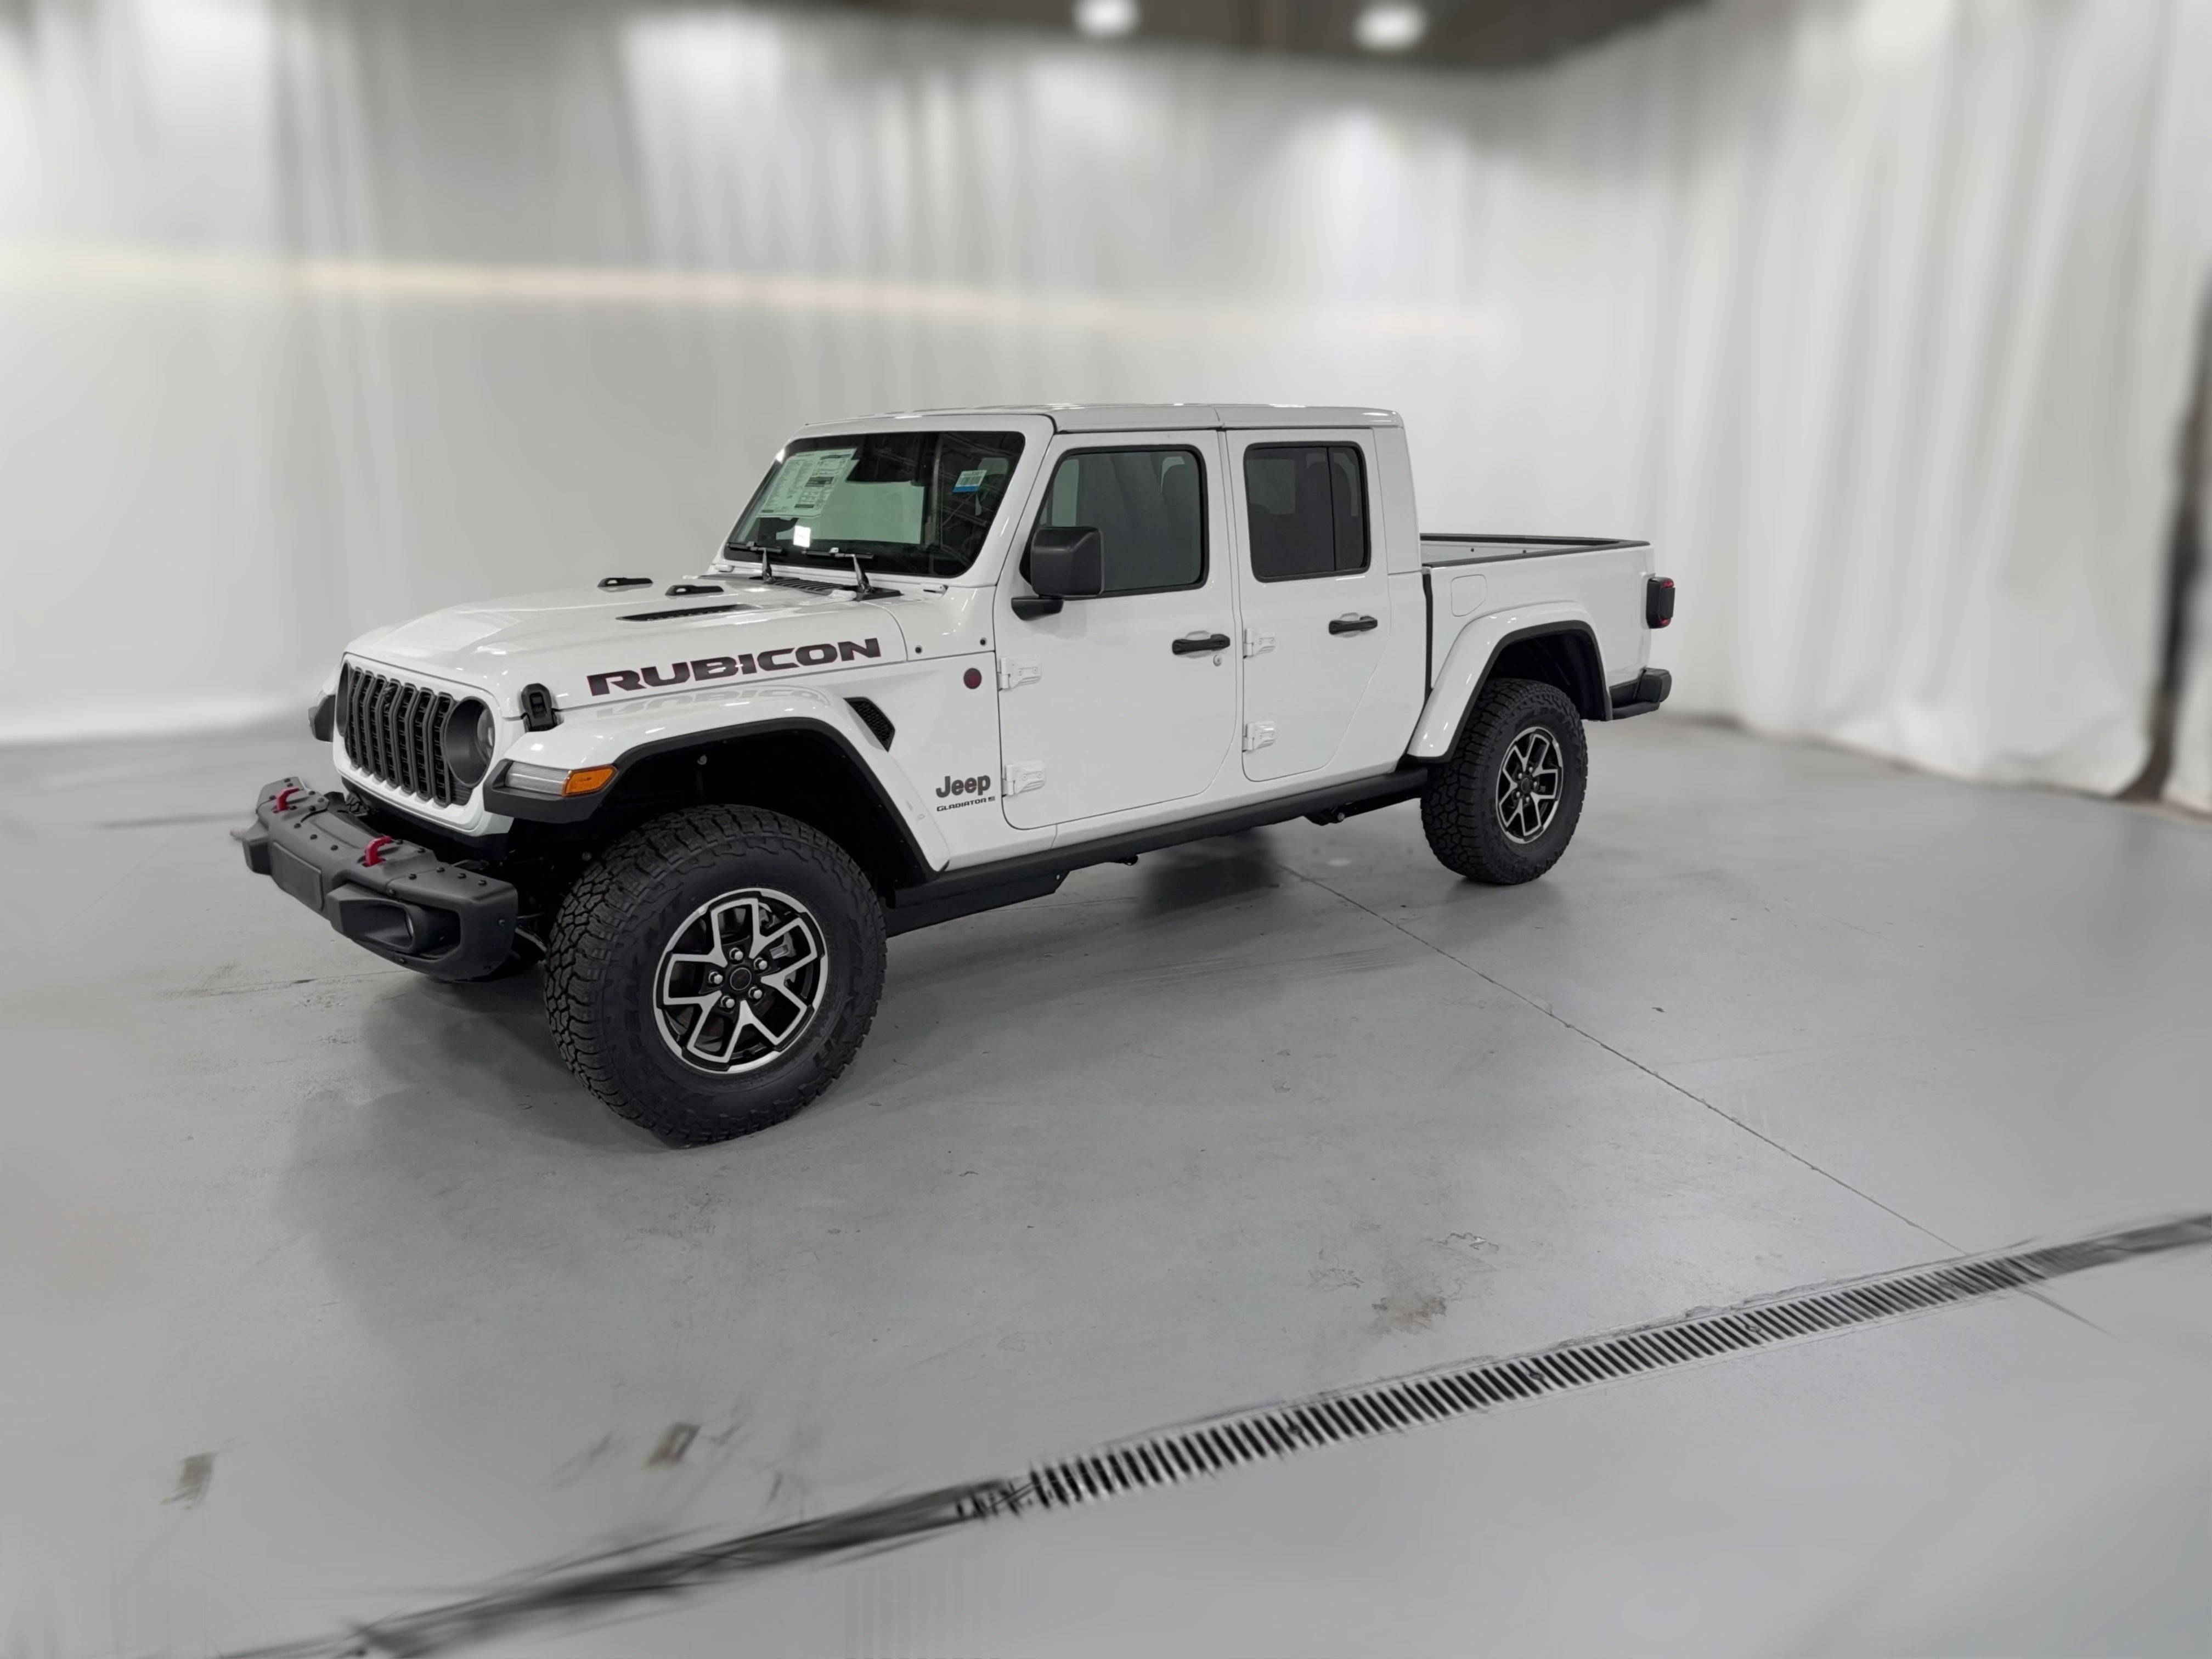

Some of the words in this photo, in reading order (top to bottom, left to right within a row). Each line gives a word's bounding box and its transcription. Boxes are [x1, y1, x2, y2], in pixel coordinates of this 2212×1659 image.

[586, 638, 881, 696] RUBICON
[936, 775, 991, 798] Jeep
[936, 798, 987, 811] GLADIATOR
